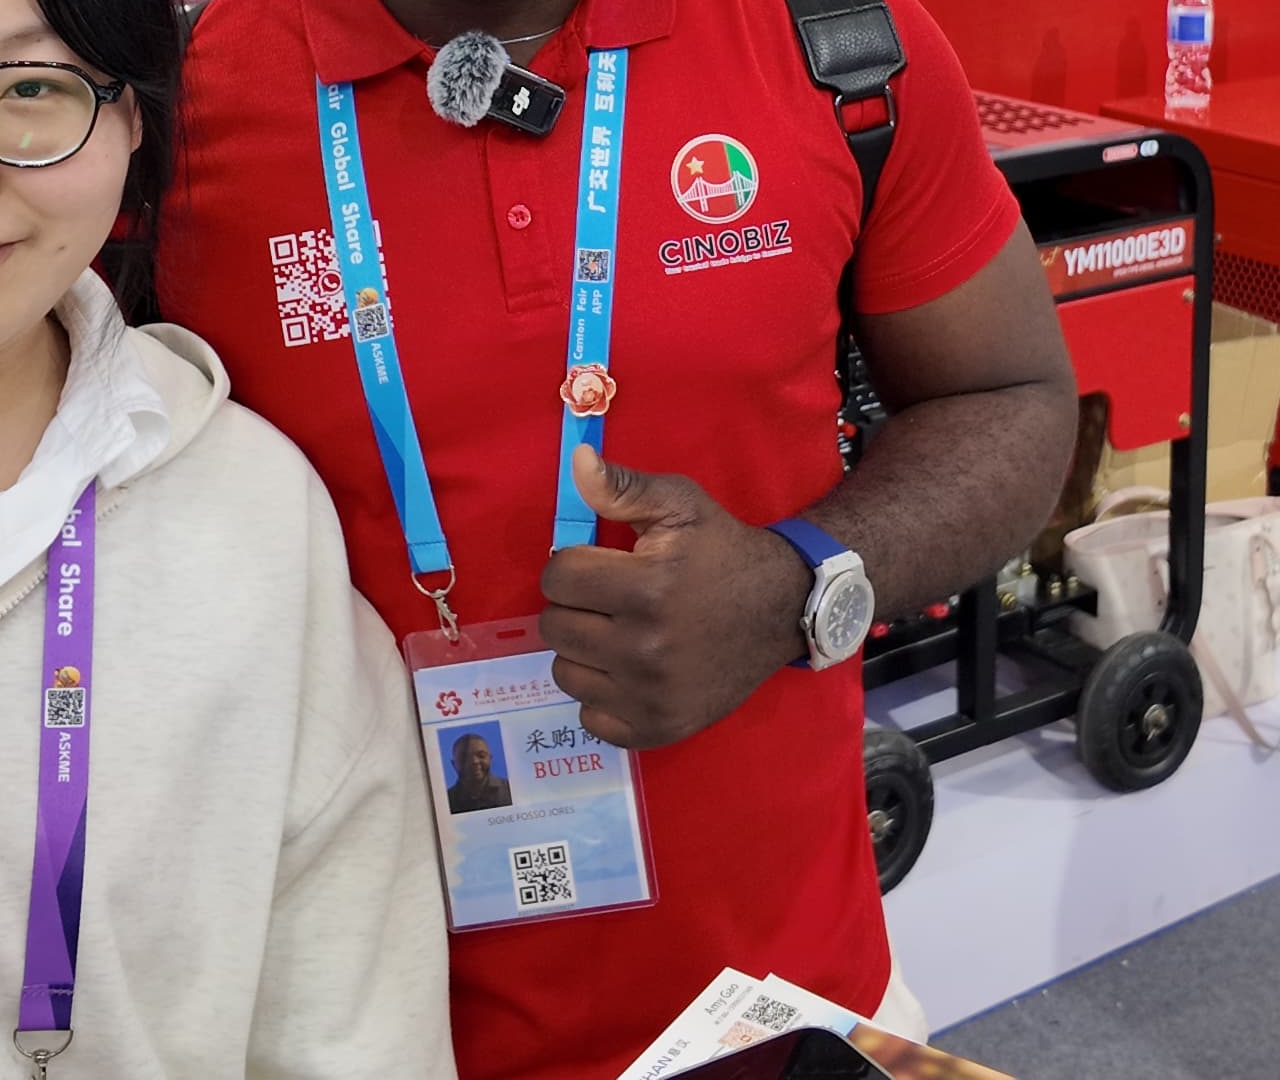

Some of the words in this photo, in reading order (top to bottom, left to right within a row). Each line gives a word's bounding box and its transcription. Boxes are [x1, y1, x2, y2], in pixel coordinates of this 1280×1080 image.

[331, 121, 356, 191] Global
[587, 125, 613, 214] 广交世界
[342, 202, 364, 265] Share
[659, 220, 793, 266] CINOBIZ
[1064, 226, 1186, 277] YM11000E3D
[576, 287, 588, 312] Fair
[591, 289, 603, 315] APP
[573, 318, 586, 361] Canton
[371, 342, 389, 385] ASKME
[57, 563, 81, 637] Share
[57, 731, 71, 783] ASKME
[533, 753, 604, 779] BUYER
[704, 992, 728, 1016] Amy
